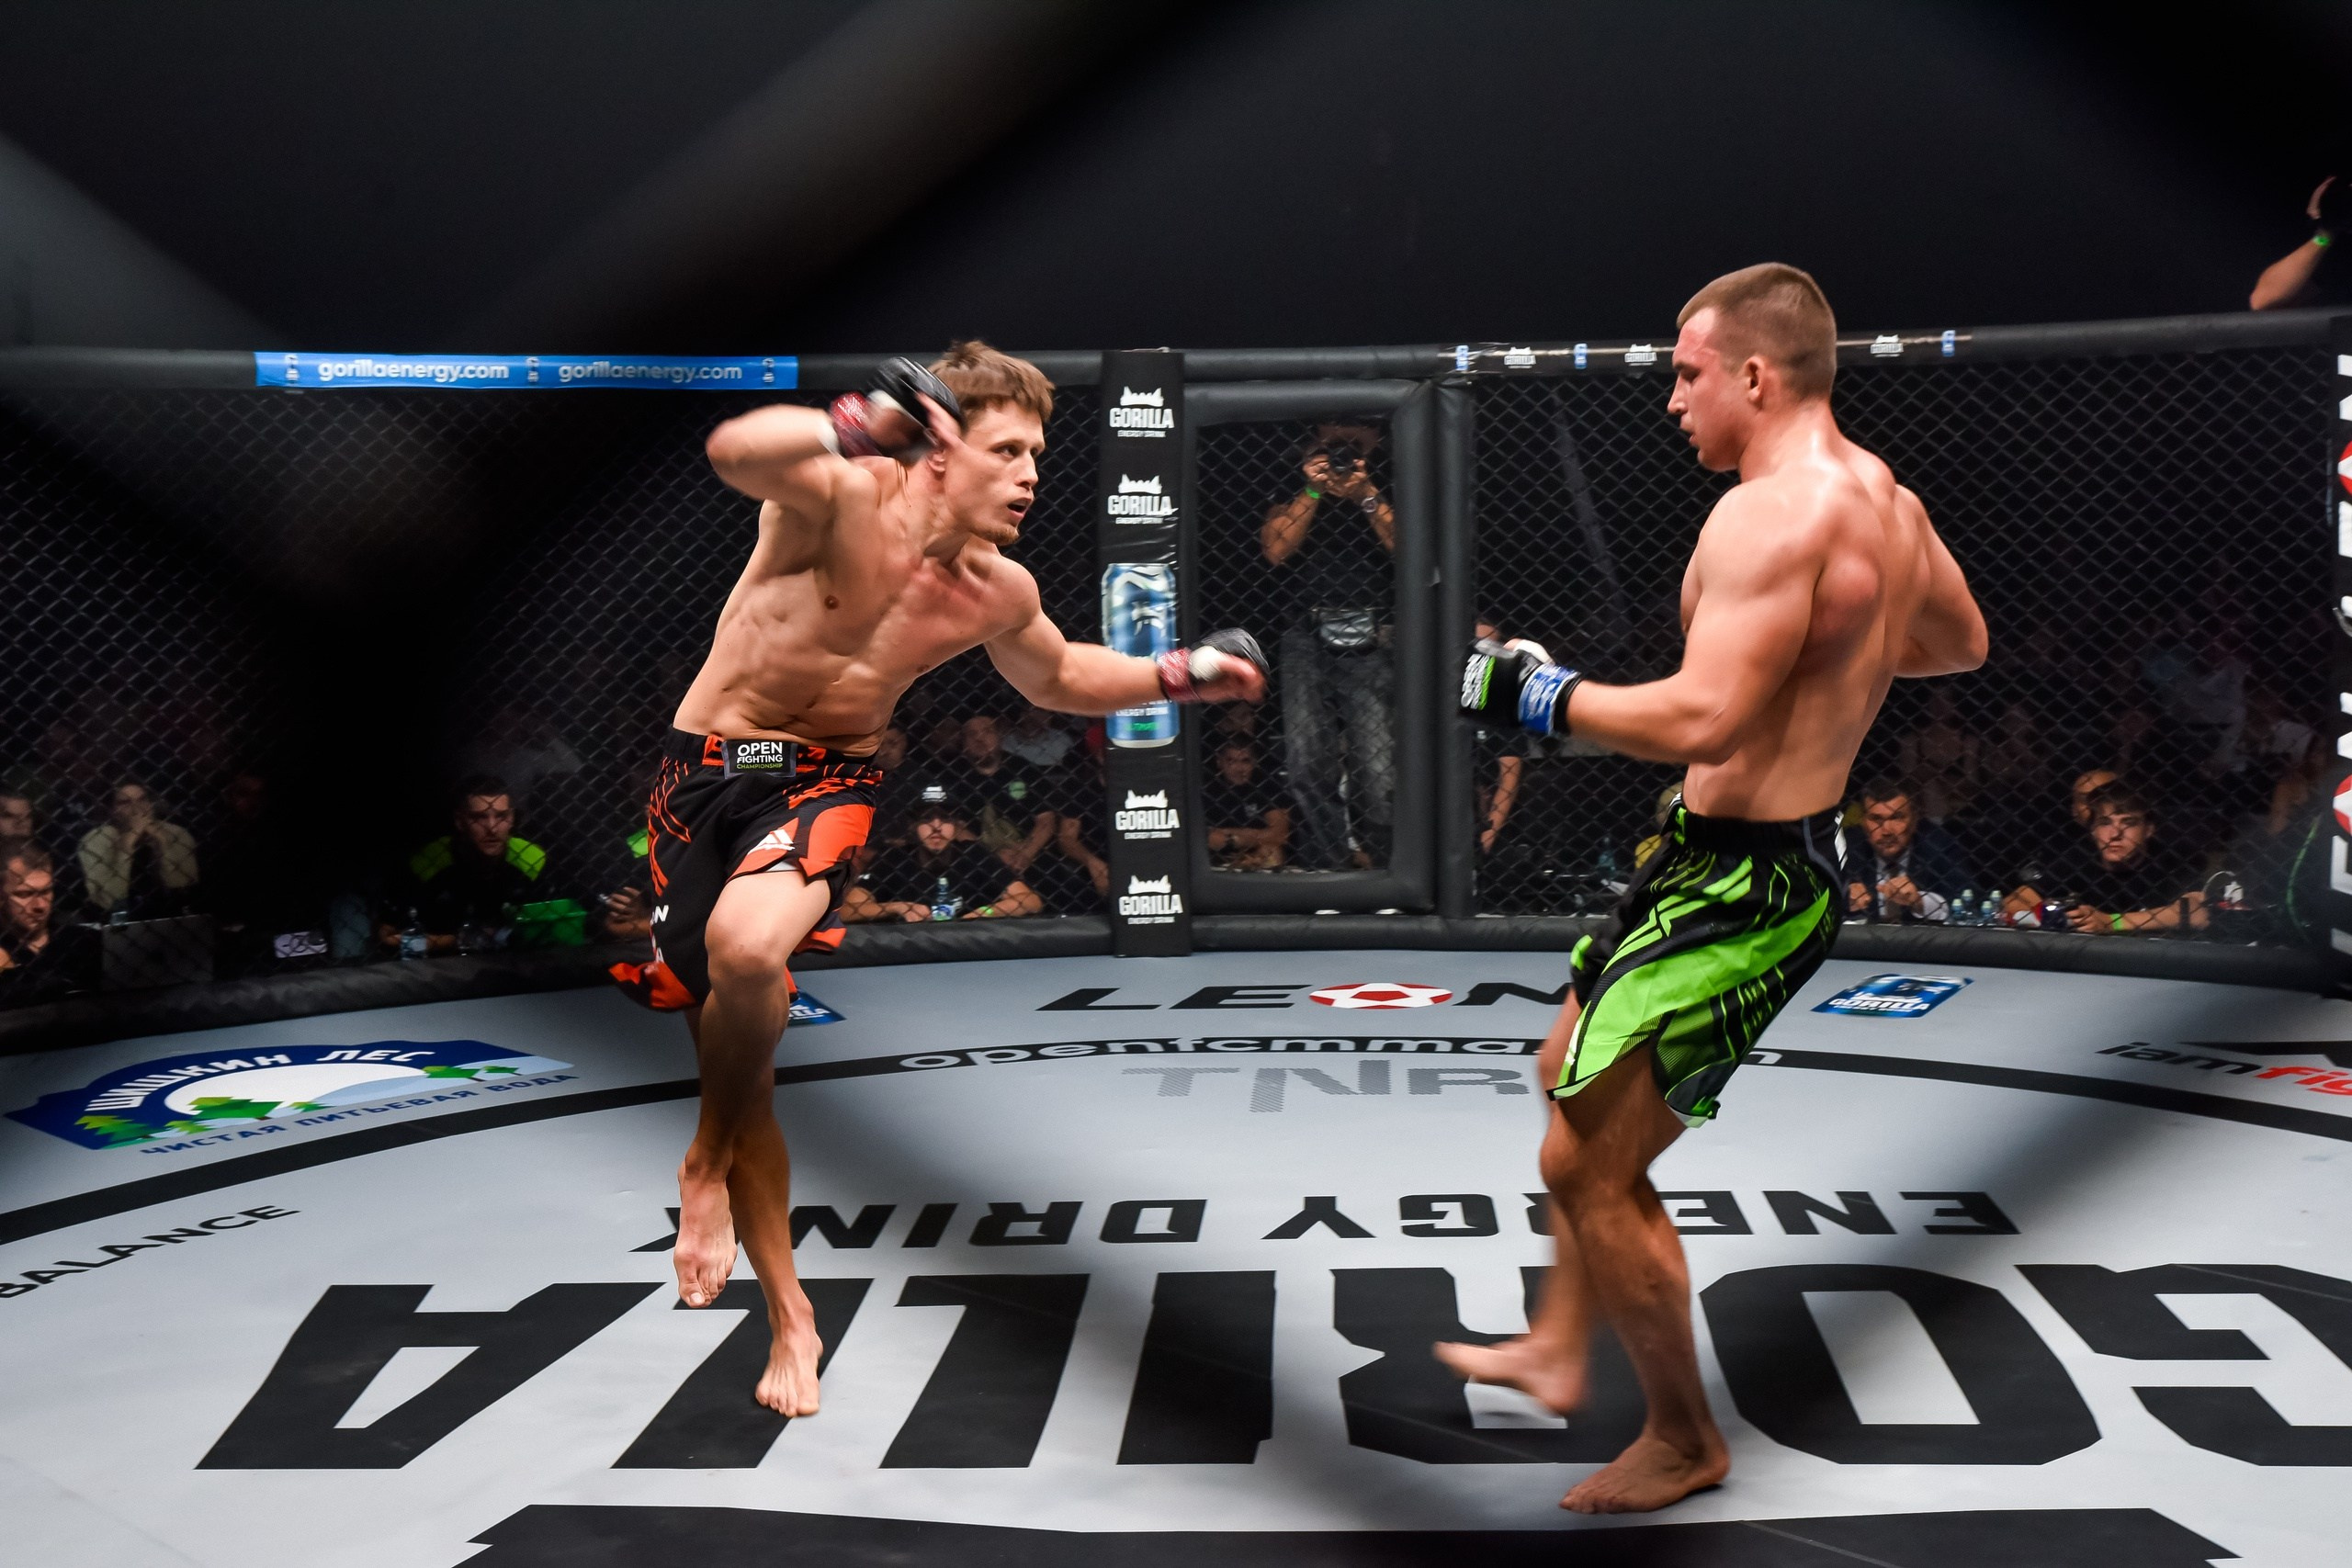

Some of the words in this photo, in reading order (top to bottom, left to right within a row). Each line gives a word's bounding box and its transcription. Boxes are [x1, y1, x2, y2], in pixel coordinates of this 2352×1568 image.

[318, 358, 509, 382] gorillaenergy.com
[559, 361, 742, 383] gorillaenergy.com
[1109, 407, 1175, 428] GORILLA
[1107, 494, 1173, 515] GORILLA
[736, 754, 783, 764] FIGHTING
[737, 741, 783, 757] OPEN
[1115, 809, 1181, 830] GORILLA
[1118, 894, 1183, 916] GORILLA
[1827, 998, 1931, 1011] GORILLA
[84, 1054, 293, 1111] ШИШКИН
[316, 1049, 435, 1063] ЛЕС
[140, 1123, 287, 1155] ЧИСТАЯ
[294, 1089, 480, 1126] ПИТЬЕВАЯ
[484, 1074, 581, 1092] ВОДА
[0, 1204, 302, 1299] BALANCE
